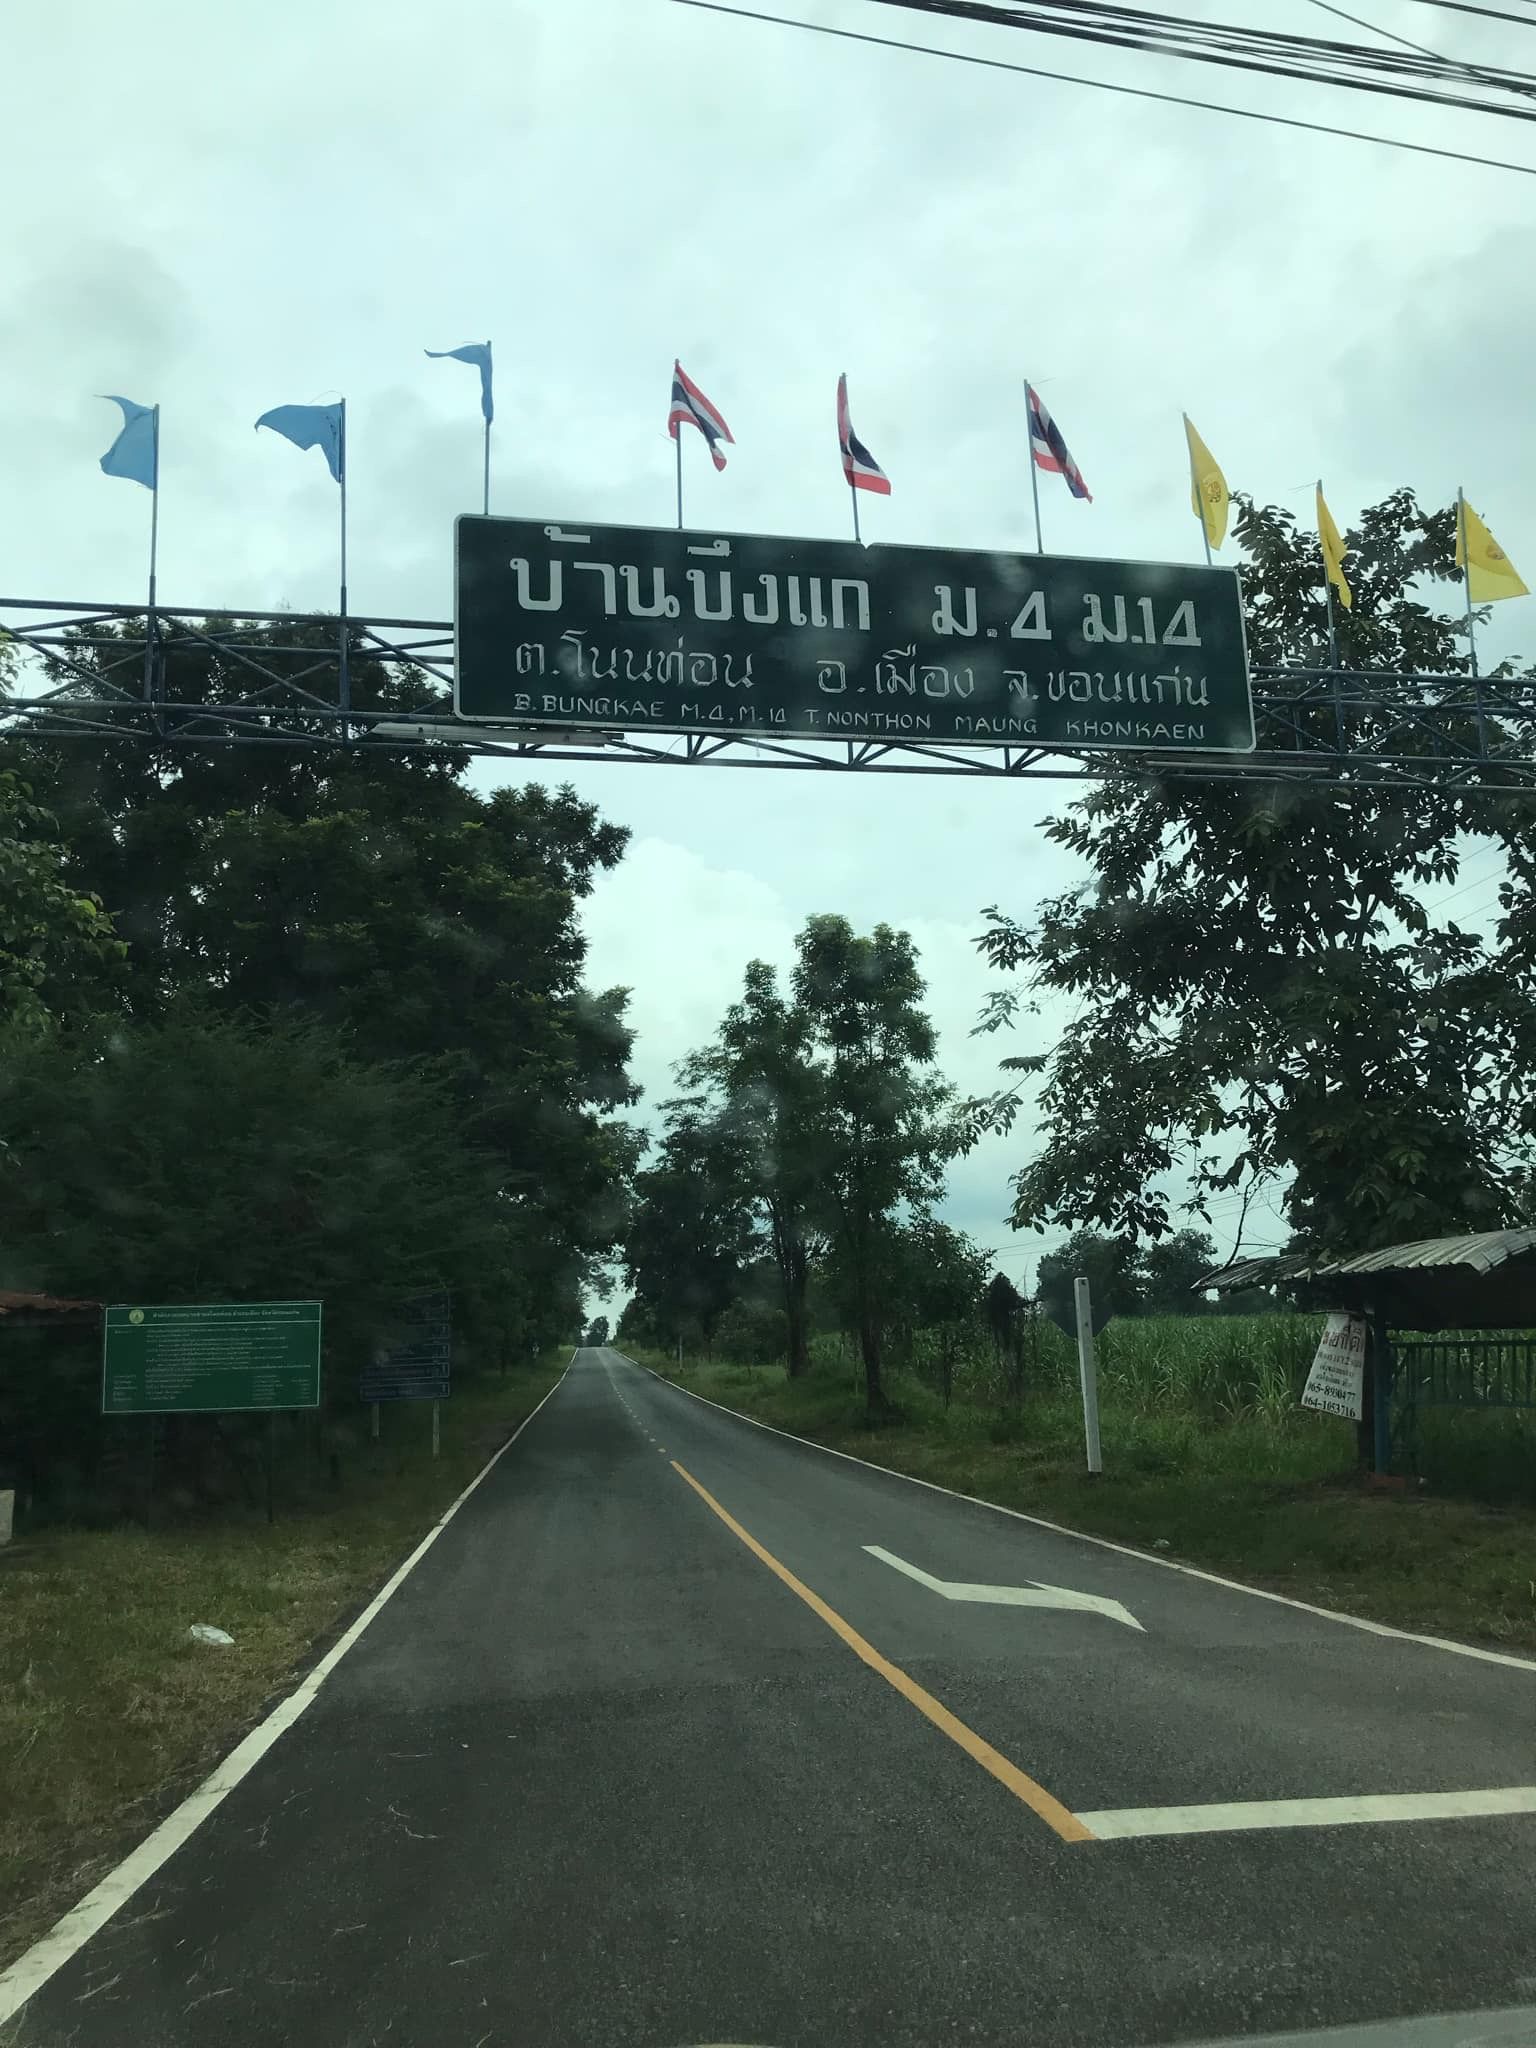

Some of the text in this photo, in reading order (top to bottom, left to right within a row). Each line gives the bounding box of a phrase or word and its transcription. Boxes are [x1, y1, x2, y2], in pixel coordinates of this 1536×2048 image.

[509, 525, 871, 631] บ้านบึงแก
[955, 715, 1038, 736] MAUNG
[1066, 719, 1206, 743] KHONKAEN
